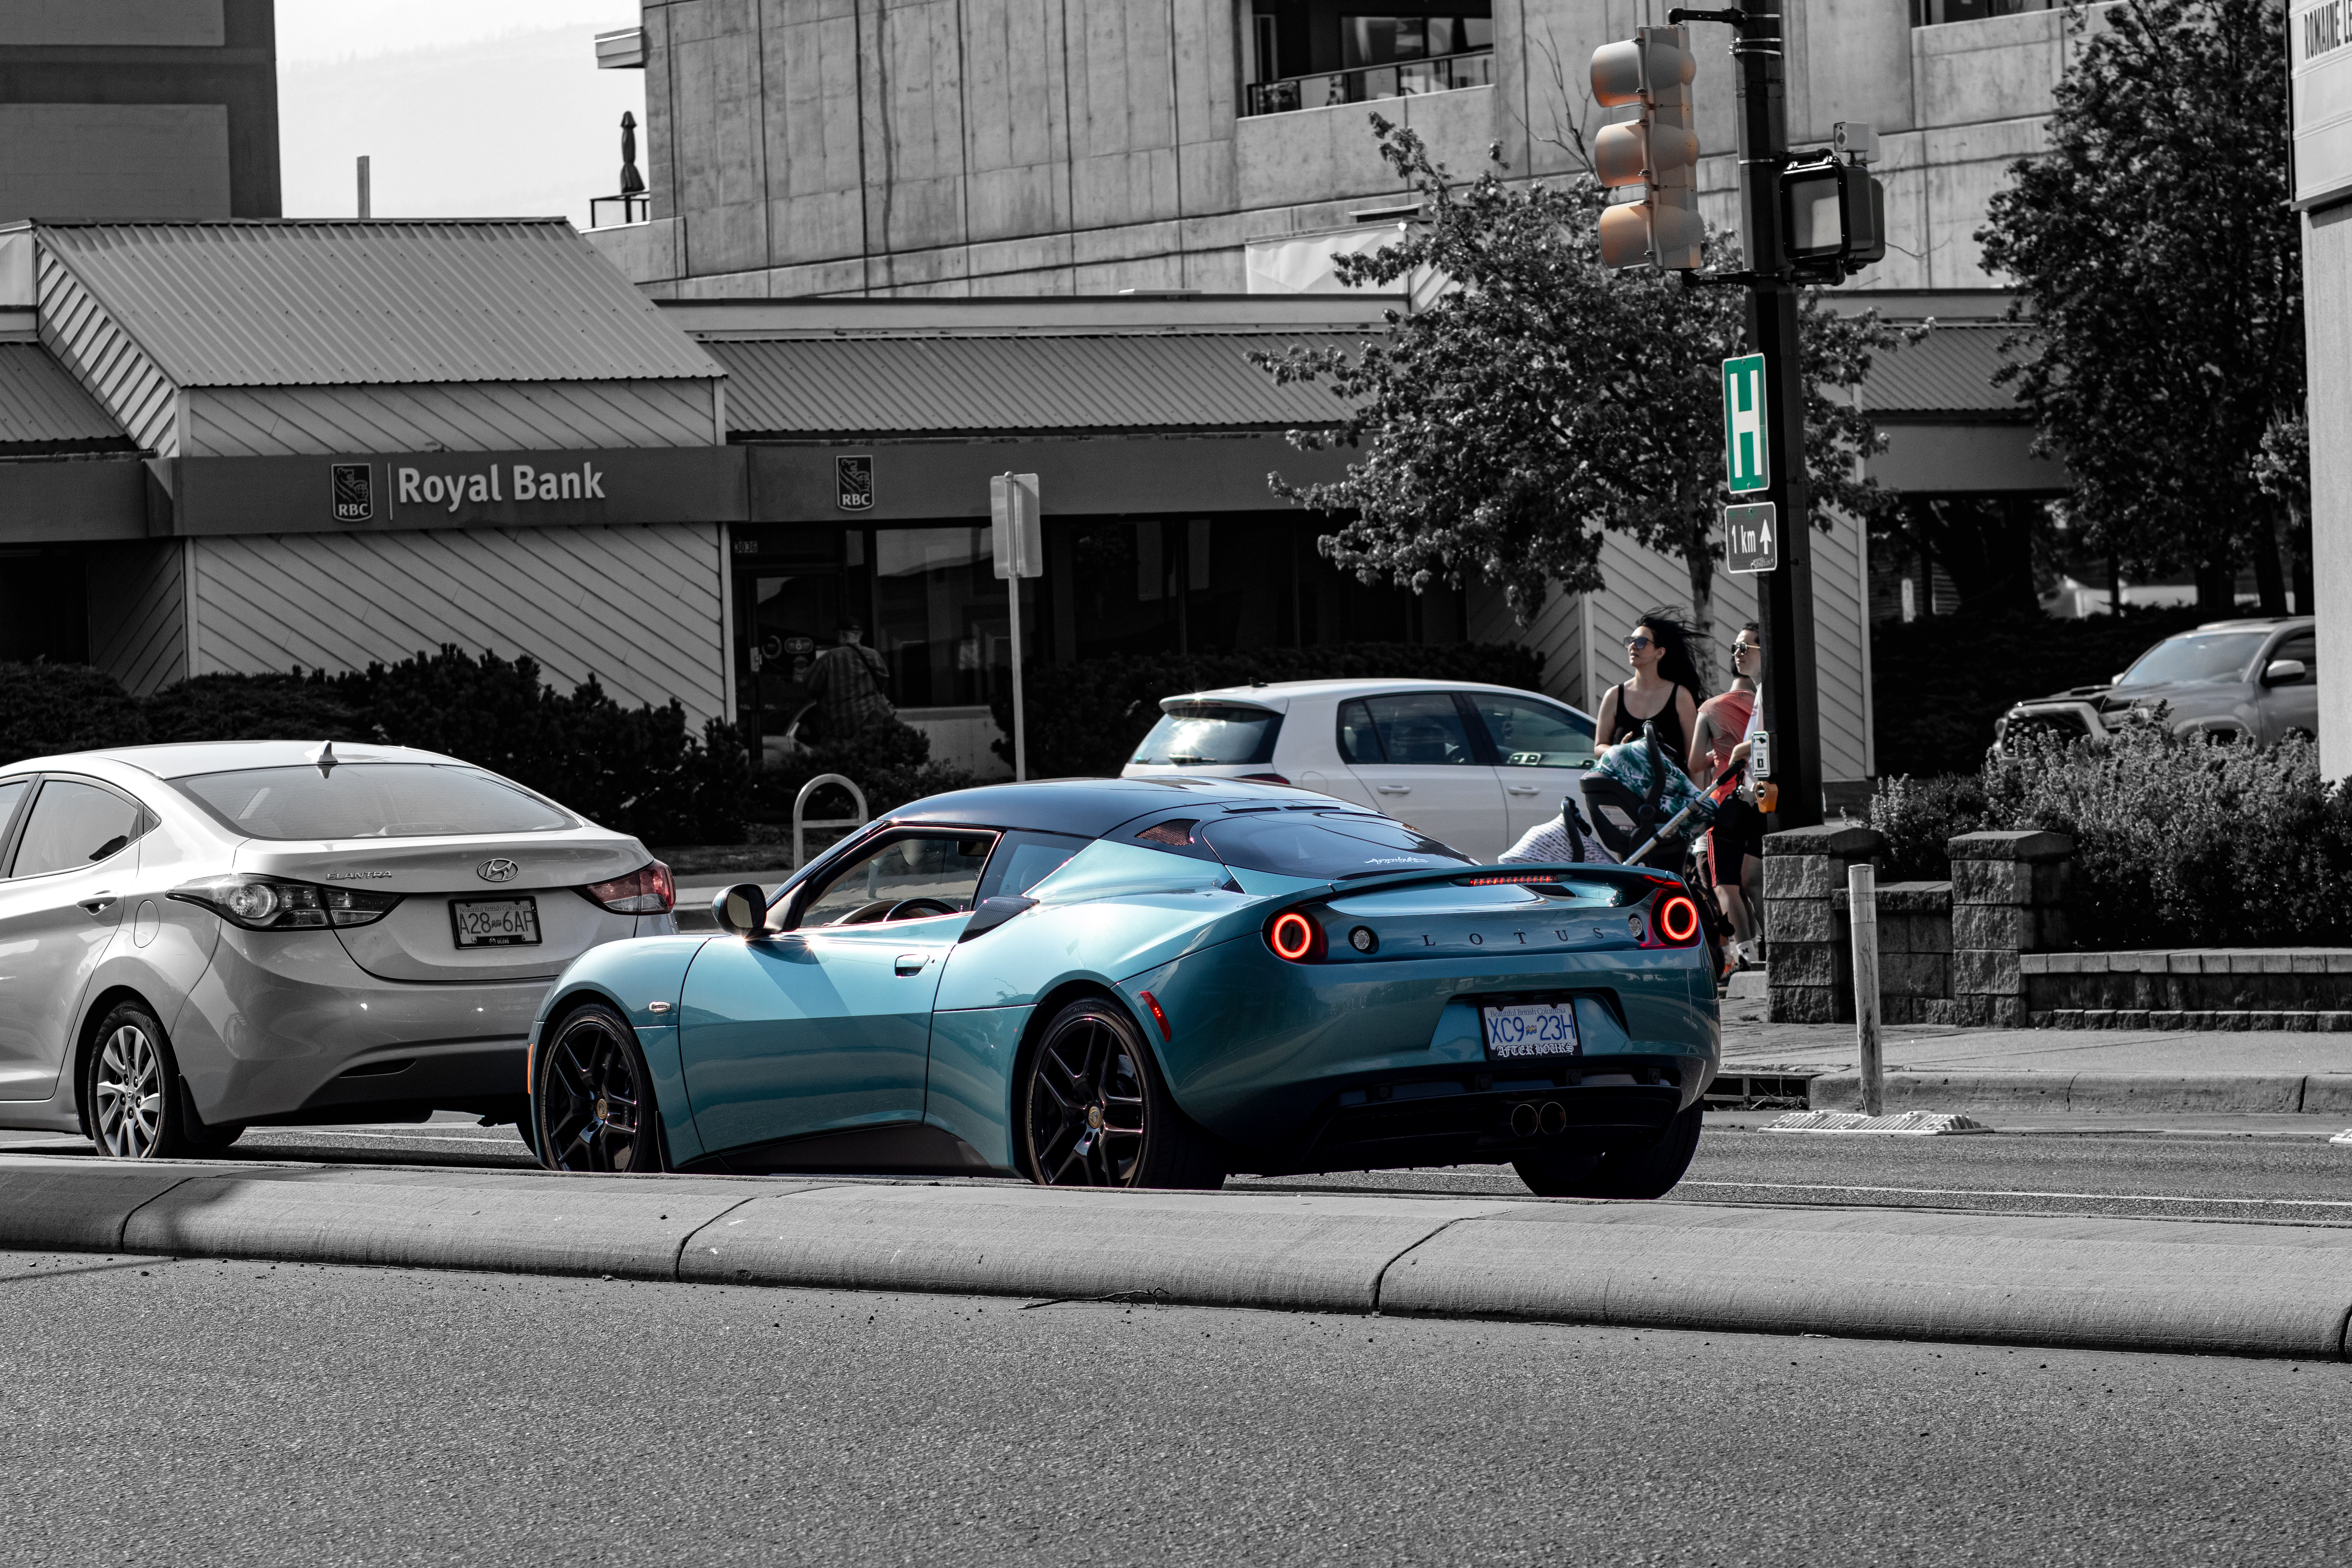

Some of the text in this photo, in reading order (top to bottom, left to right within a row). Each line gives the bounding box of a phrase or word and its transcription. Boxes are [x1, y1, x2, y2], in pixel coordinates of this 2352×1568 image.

[1730, 370, 1762, 478] H
[398, 462, 606, 513] Royal Bank
[842, 493, 870, 505] RBC
[338, 504, 369, 517] RBC
[1731, 524, 1756, 554] 1 km
[326, 871, 392, 880] ELANTRA
[460, 910, 534, 935] A28 6AP
[1422, 927, 1604, 947] LOTUS
[1490, 1007, 1566, 1017] Beautiful British Columbia
[1488, 1014, 1575, 1044] XC9 23H
